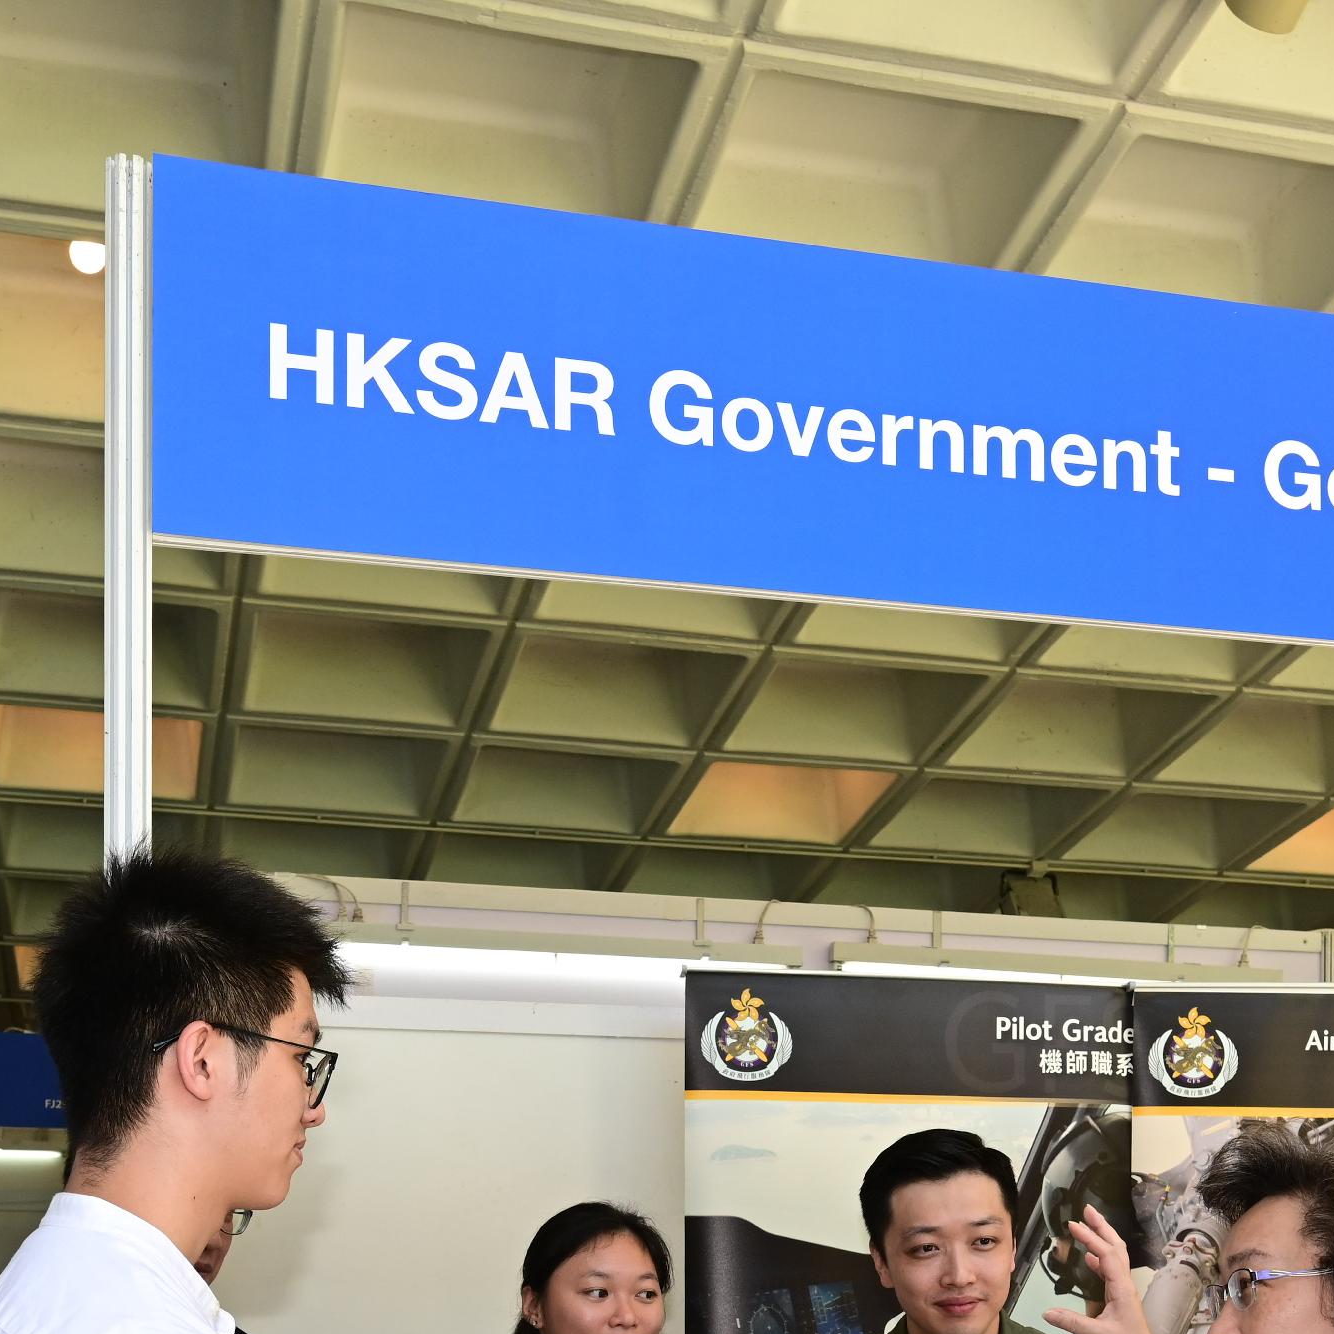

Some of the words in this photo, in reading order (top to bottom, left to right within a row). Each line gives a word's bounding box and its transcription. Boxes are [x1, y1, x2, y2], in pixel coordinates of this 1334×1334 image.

[269, 322, 615, 436] HKSAR
[649, 369, 1180, 496] Government
[1208, 467, 1235, 483] -
[996, 1016, 1053, 1041] Pilot
[1062, 1019, 1134, 1045] Grade
[1039, 1048, 1134, 1078] 機師職系
[44, 1098, 65, 1109] FJ2
